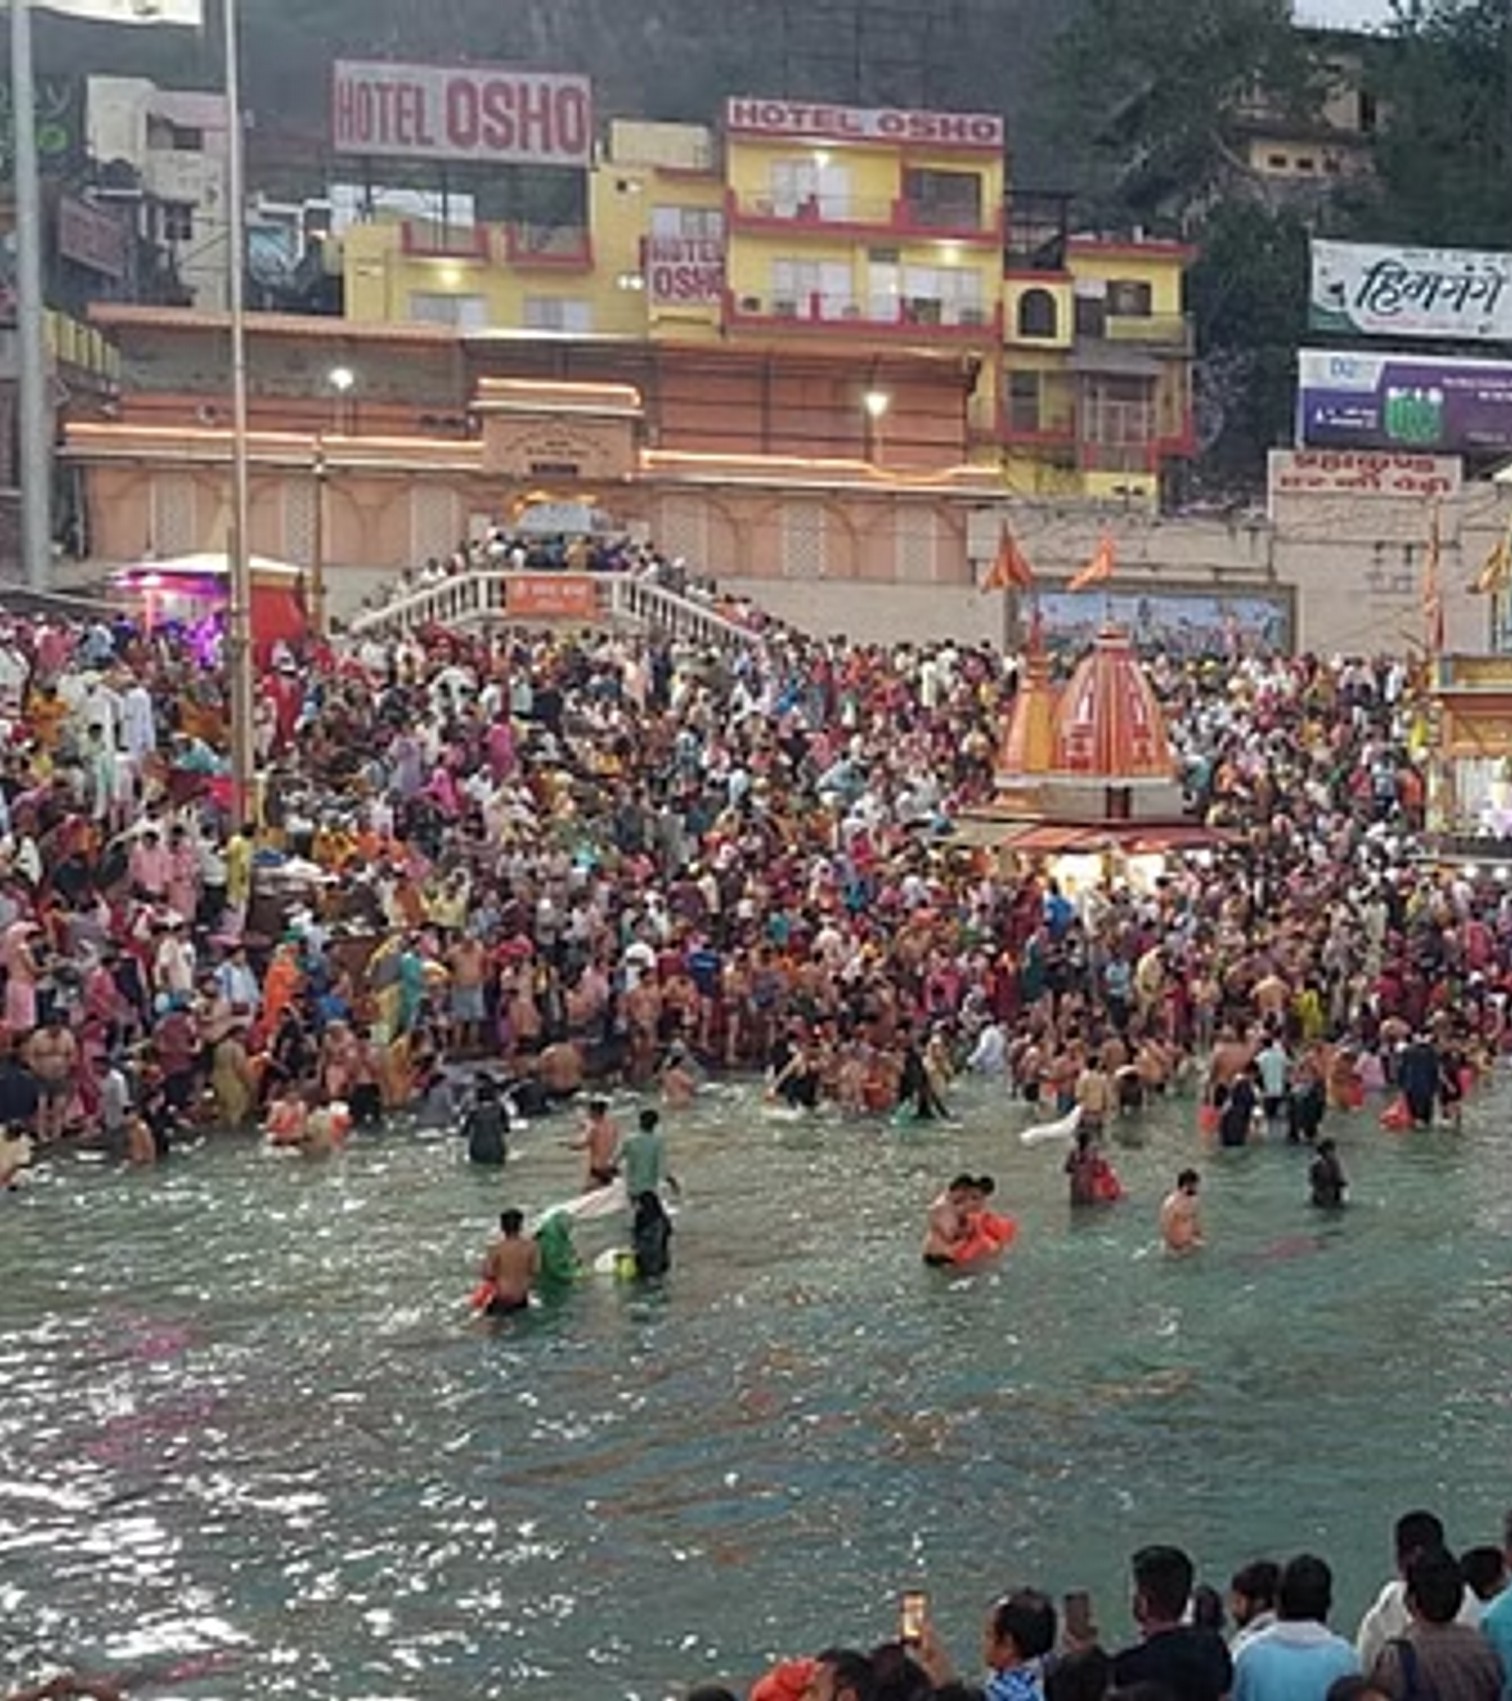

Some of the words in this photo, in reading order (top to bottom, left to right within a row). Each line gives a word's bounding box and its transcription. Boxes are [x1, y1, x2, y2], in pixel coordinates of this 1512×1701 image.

[336, 77, 435, 147] HOTEL
[446, 77, 589, 155] OSHO
[732, 102, 866, 132] HOTEL
[877, 113, 998, 142] OSHO
